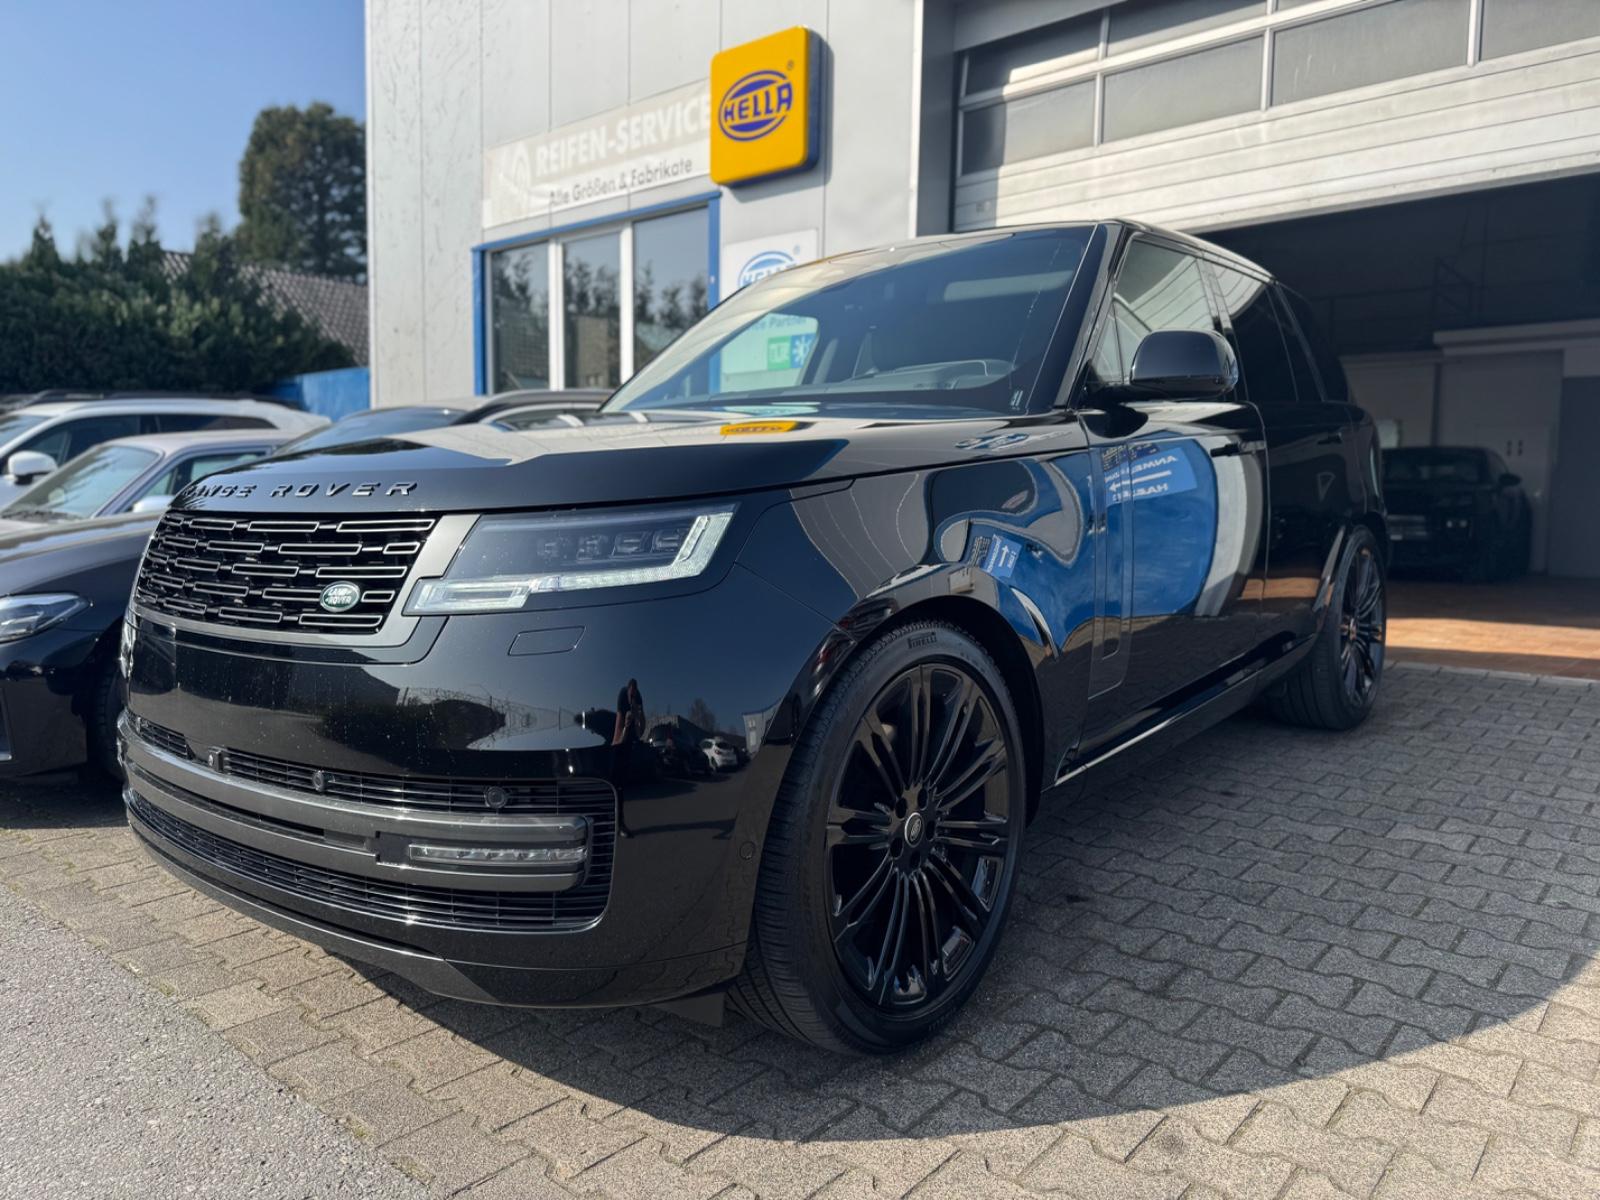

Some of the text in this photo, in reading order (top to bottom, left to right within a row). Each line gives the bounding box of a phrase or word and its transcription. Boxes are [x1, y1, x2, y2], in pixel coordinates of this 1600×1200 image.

[724, 82, 793, 122] HELLA
[535, 93, 710, 178] REIFEN-SERVICE
[619, 172, 629, 190] &
[631, 158, 693, 188] Fabrikate
[269, 482, 418, 498] ROVER
[327, 595, 352, 605] ROVER
